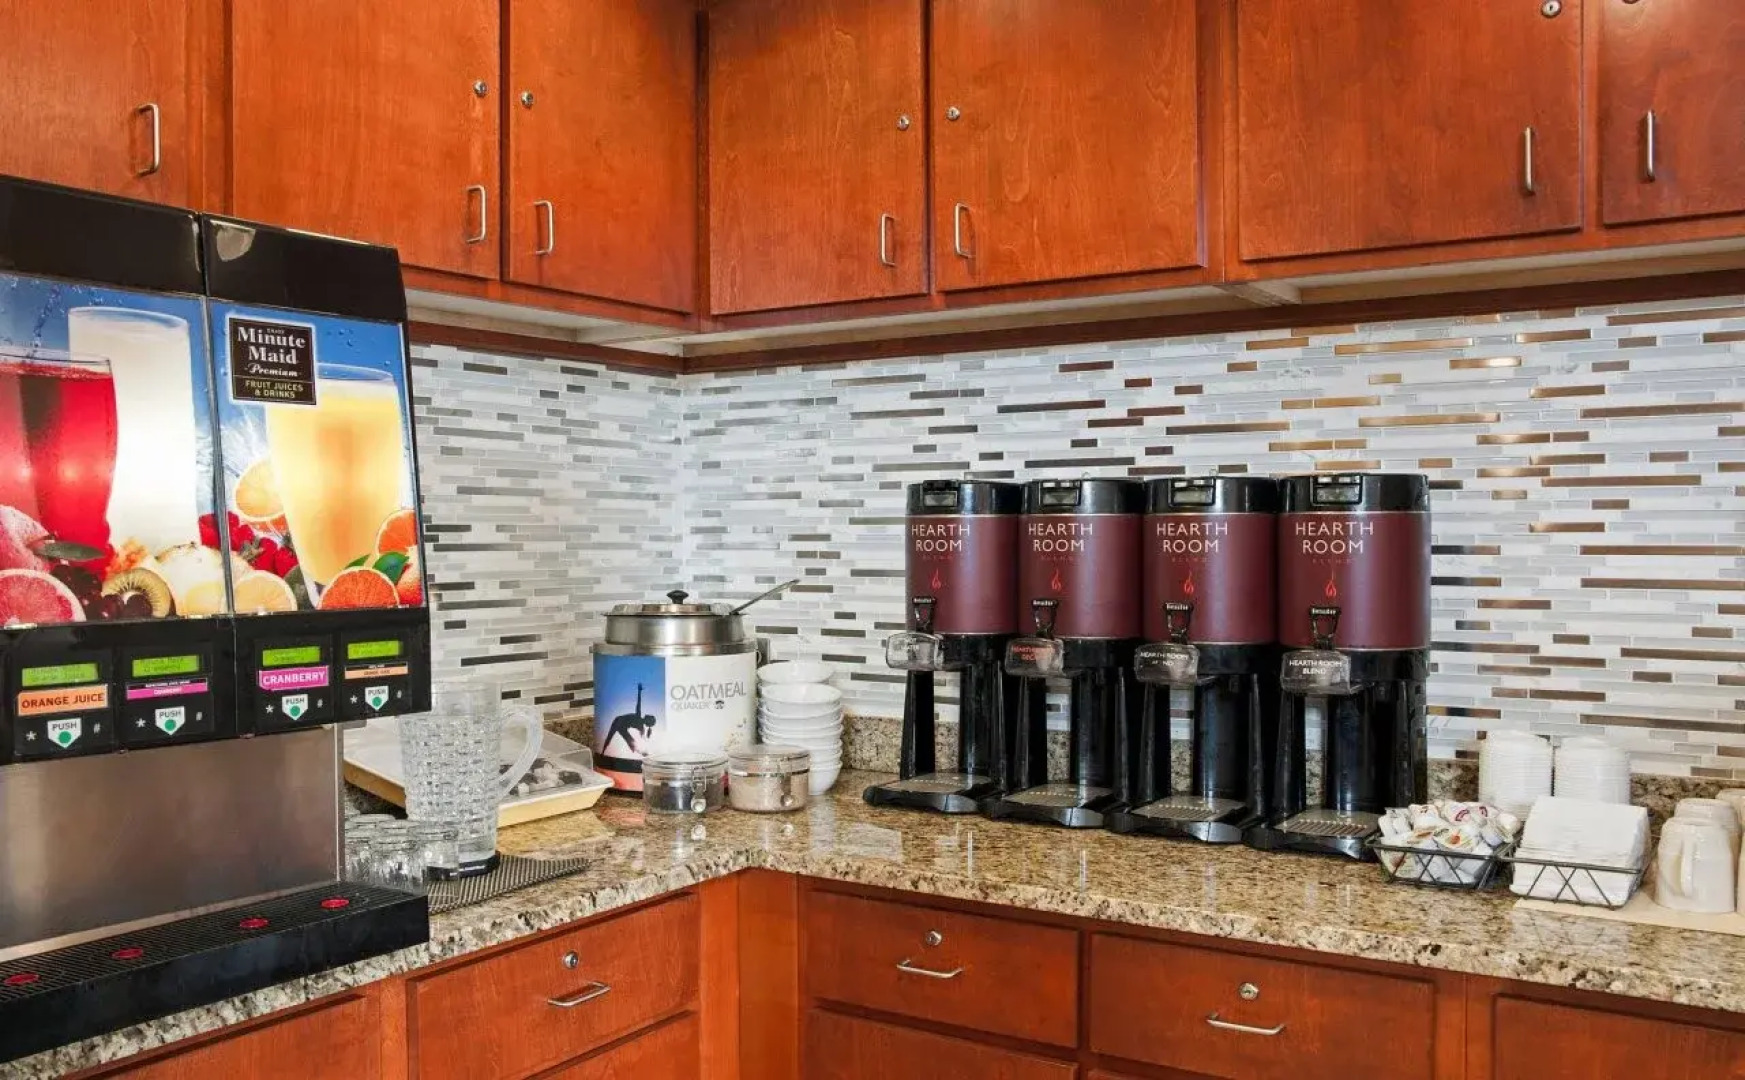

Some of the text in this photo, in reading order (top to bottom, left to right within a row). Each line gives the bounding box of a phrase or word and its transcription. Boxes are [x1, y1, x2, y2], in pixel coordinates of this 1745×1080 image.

[237, 326, 306, 349] Minute
[248, 345, 297, 365] Maid
[247, 362, 298, 377] Premium
[245, 380, 304, 392] FRUIT JUICES
[263, 389, 296, 398] DRINKS
[911, 524, 970, 537] HEARTH
[1028, 522, 1093, 536] HEARTH
[1156, 521, 1228, 537] HEARTH
[1295, 521, 1374, 536] HEARTH
[915, 539, 962, 552] ROOM
[1033, 539, 1085, 552] ROOM
[1163, 539, 1219, 553] ROOM
[1302, 539, 1364, 555] ROOM
[1289, 659, 1318, 667] HEARTH
[1302, 667, 1327, 675] BLEND
[262, 671, 325, 686] CRANBERRY
[670, 681, 747, 700] OATMEAL
[21, 693, 105, 709] ORANGE JUICE
[285, 697, 305, 705] PUSH
[670, 700, 709, 712] QUAKER
[159, 710, 181, 718] PUSH
[51, 722, 77, 732] PUSH
